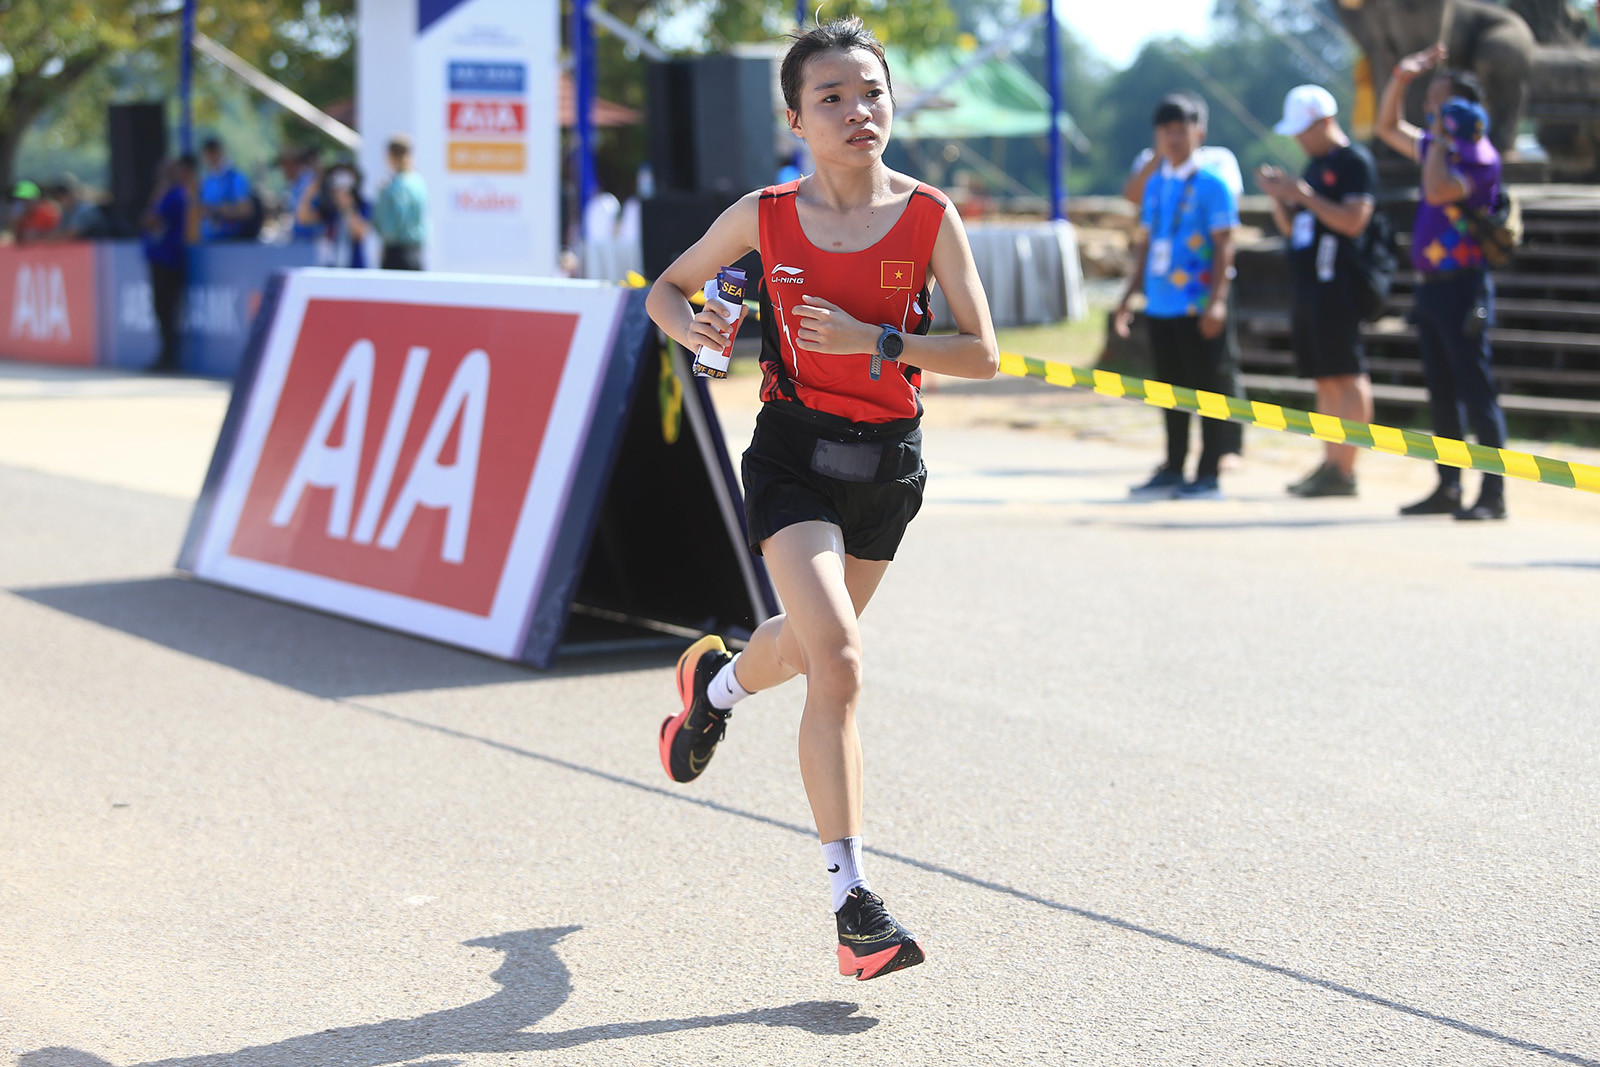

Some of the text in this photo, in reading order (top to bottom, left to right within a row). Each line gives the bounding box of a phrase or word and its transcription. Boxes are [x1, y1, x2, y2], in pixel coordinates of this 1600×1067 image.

[454, 103, 521, 129] AIA
[721, 281, 742, 298] SEA
[771, 276, 805, 285] LI-NING
[10, 262, 72, 343] AIA
[269, 338, 491, 565] AIA
